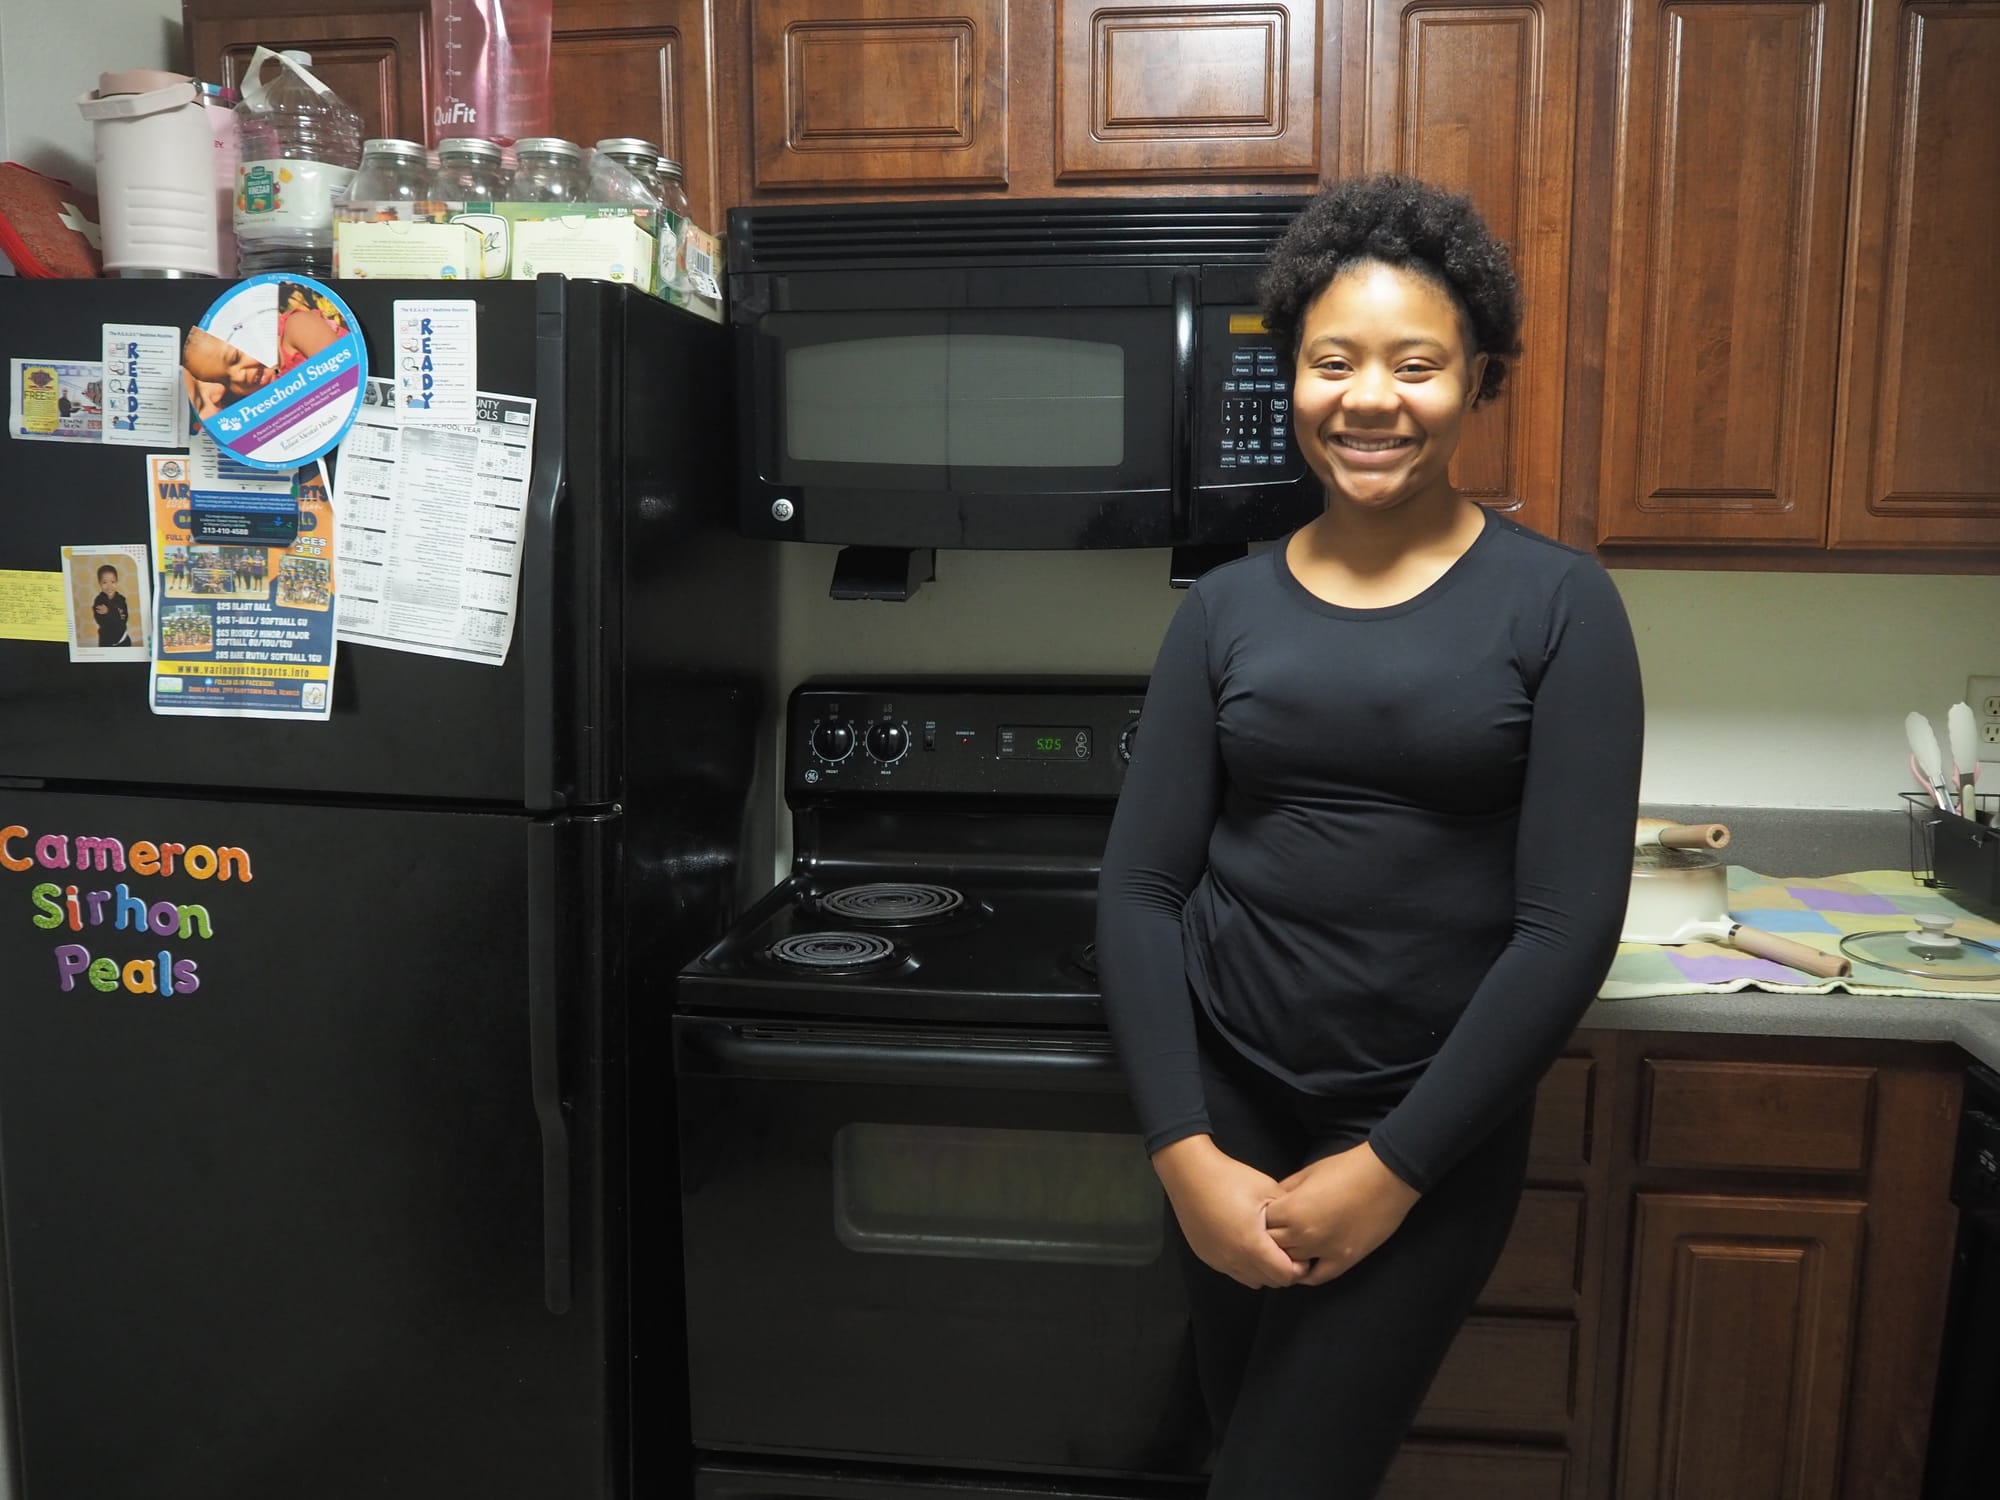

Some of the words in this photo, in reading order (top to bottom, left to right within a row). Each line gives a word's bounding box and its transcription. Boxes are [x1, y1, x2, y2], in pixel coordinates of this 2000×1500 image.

[434, 103, 476, 126] QuiFit
[248, 185, 270, 194] VINEGAR
[421, 318, 434, 409] READY
[127, 342, 139, 431] READY
[239, 374, 307, 423] Preschool
[307, 348, 351, 382] Stages
[464, 426, 481, 434] YEAR
[216, 602, 231, 611] $25
[231, 602, 253, 611] BLAST
[254, 602, 272, 612] BALL
[216, 615, 231, 625] $45
[260, 617, 296, 626] SOFTBALL
[216, 638, 247, 647] SOFTBALL
[270, 652, 307, 662] SOFTBALL
[177, 664, 310, 678] www.varinayouthsports.info
[0, 825, 253, 883] Cameron
[32, 883, 213, 939] Sirhon
[54, 944, 200, 997] Peals
